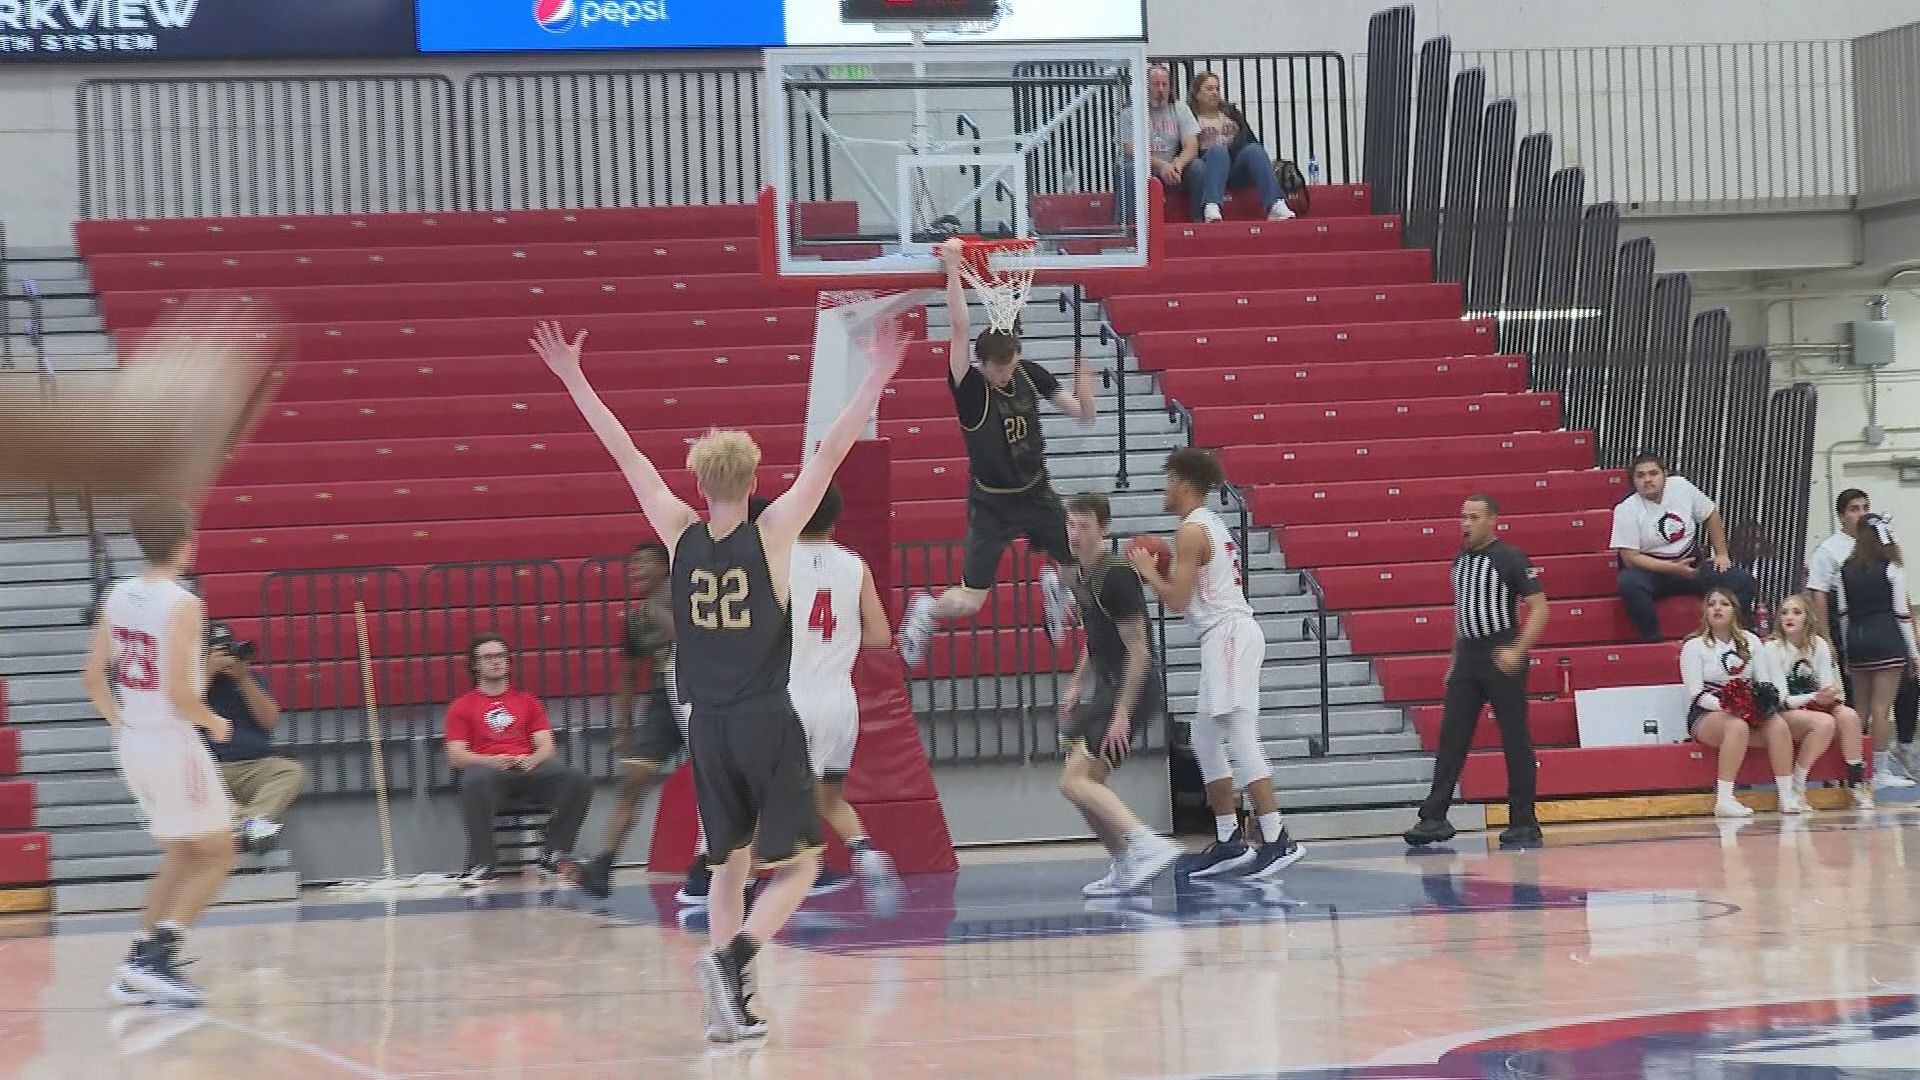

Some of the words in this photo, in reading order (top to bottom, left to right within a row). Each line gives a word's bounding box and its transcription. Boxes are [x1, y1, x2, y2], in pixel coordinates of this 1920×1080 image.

[580, 0, 668, 27] pepsi
[40, 34, 158, 50] SYSTEM
[1003, 415, 1028, 444] 20
[690, 568, 752, 629] 22
[808, 588, 837, 643] 4
[112, 626, 159, 693] 23
